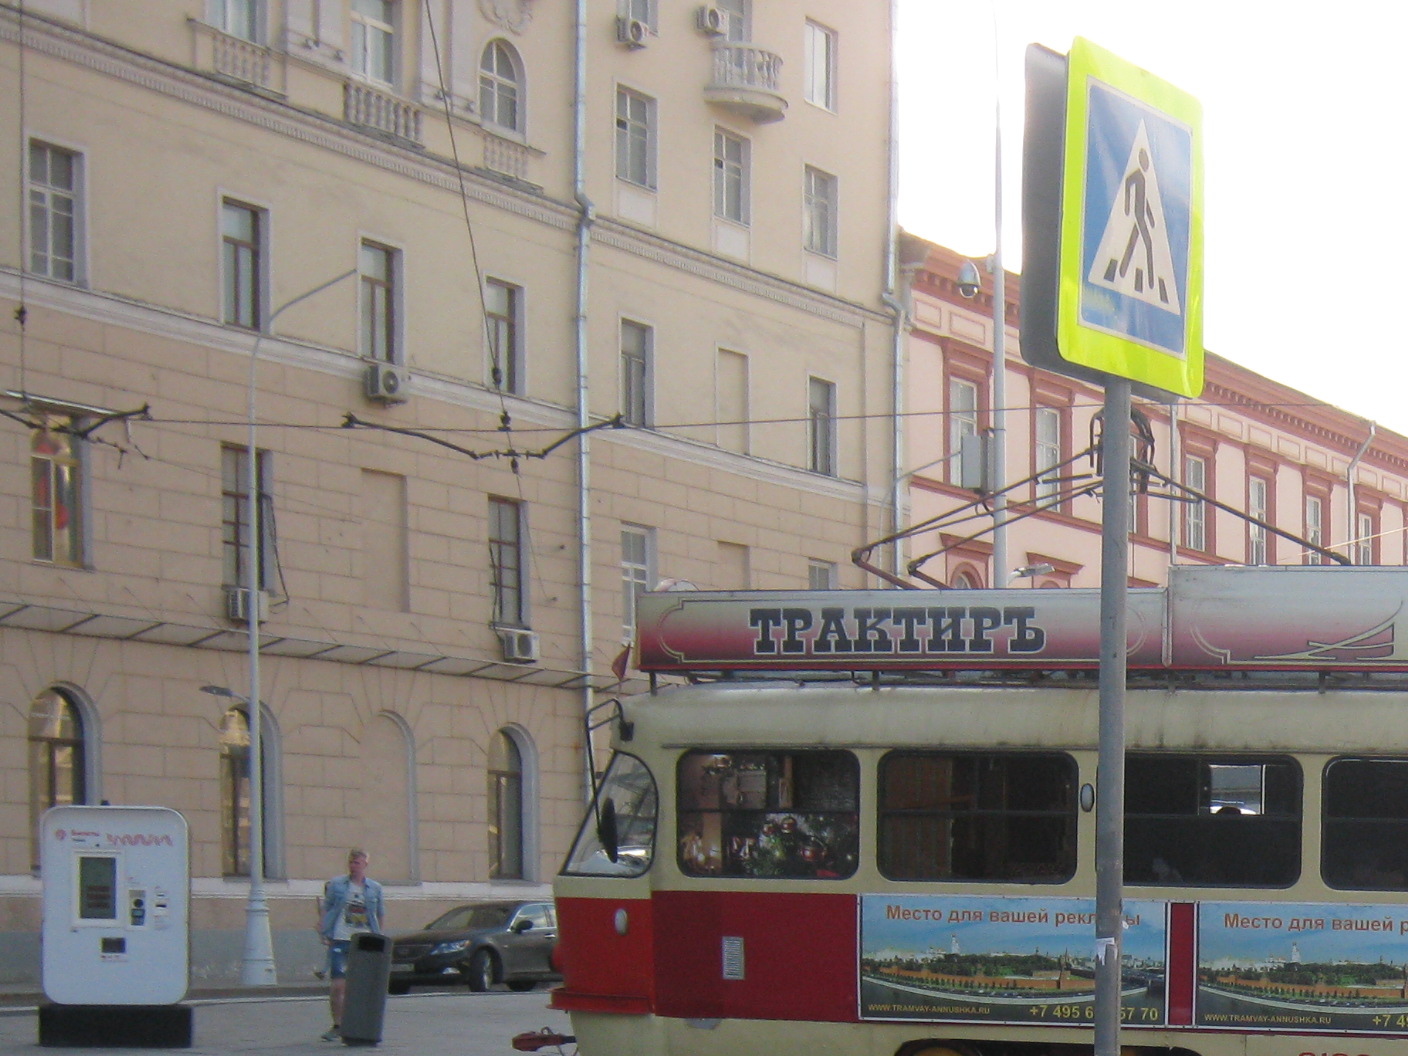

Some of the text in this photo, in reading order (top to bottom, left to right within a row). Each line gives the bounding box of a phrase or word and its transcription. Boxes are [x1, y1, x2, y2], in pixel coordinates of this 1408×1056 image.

[749, 606, 1047, 656] ТРАКТИРЪ
[886, 904, 1140, 927] Место для вашей реклы
[1224, 912, 1283, 930] Место
[1288, 916, 1324, 932] для
[1331, 915, 1393, 932] вашей
[868, 1004, 991, 1015] WWW.TRAMVAY-ANNUSHKA.RU
[1029, 1005, 1046, 1018] +7
[1052, 1005, 1081, 1019] 495
[1120, 1007, 1135, 1020] 57
[1141, 1007, 1158, 1021] 70
[1204, 1013, 1332, 1025] WWW.TRAMVAY-ANNUSHKA.RU
[1372, 1014, 1390, 1028] +7
